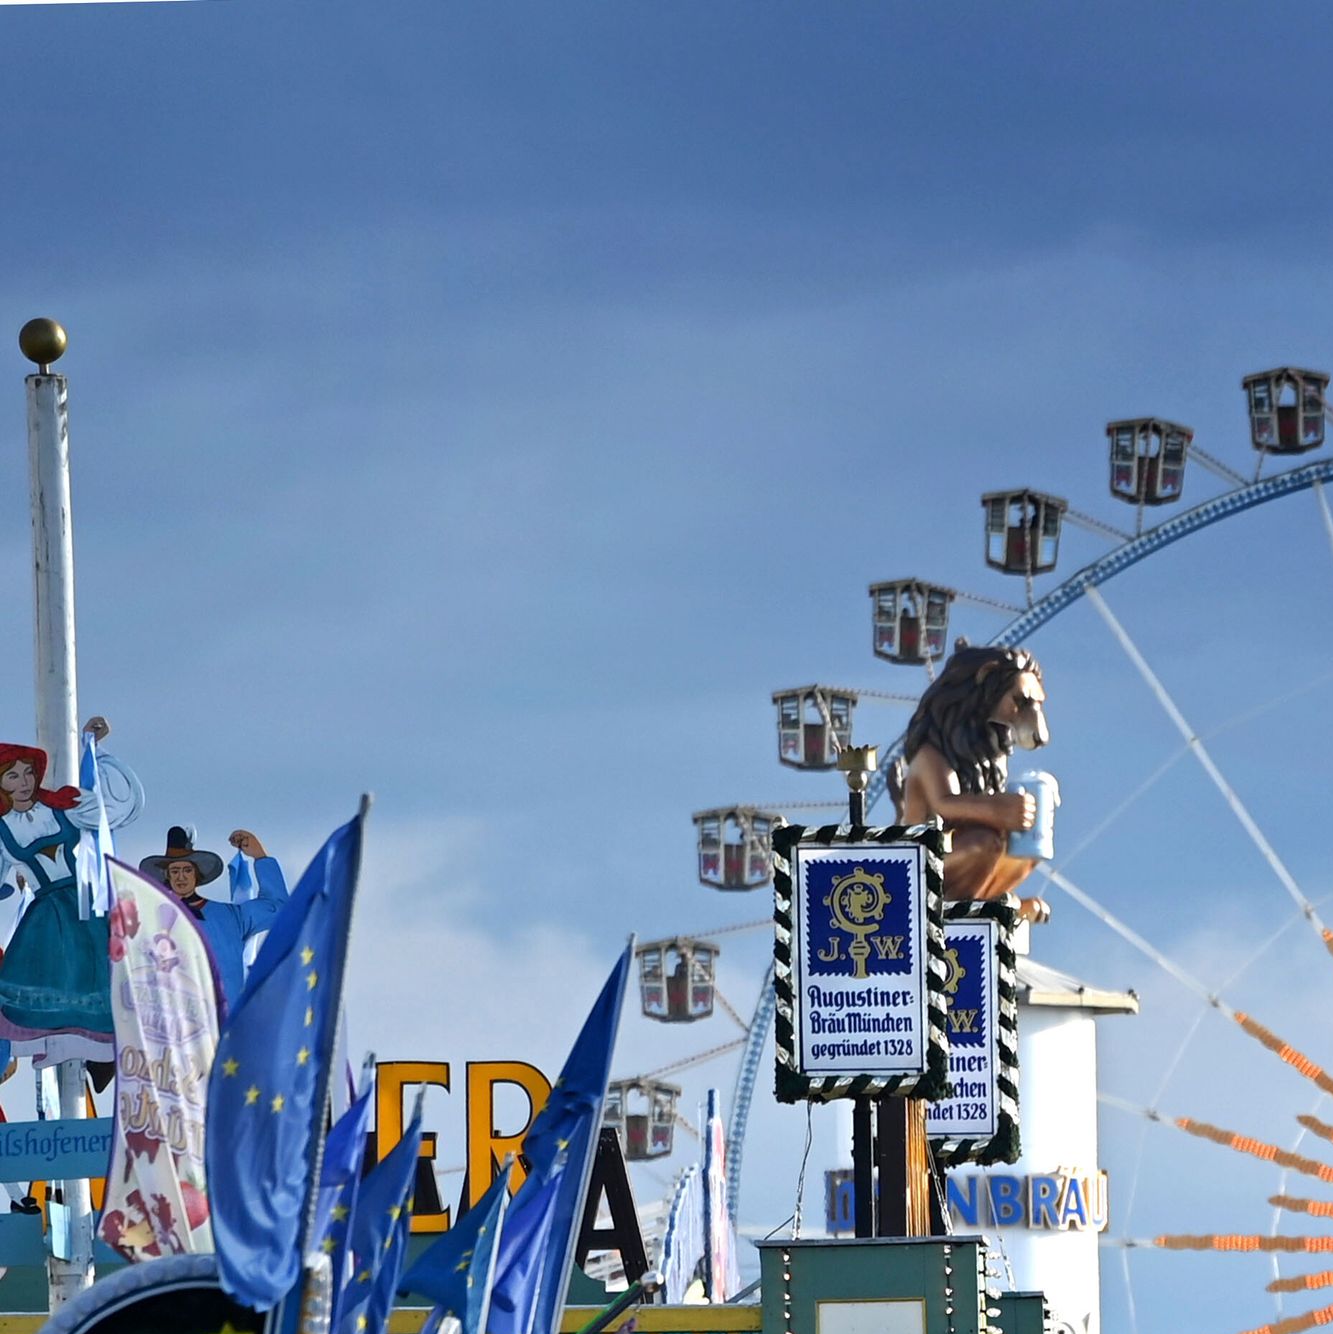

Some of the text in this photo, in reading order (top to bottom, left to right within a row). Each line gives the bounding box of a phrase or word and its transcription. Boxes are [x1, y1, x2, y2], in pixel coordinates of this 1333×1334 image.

[811, 1039, 913, 1060] gegründet 1328
[957, 1103, 987, 1120] 1328
